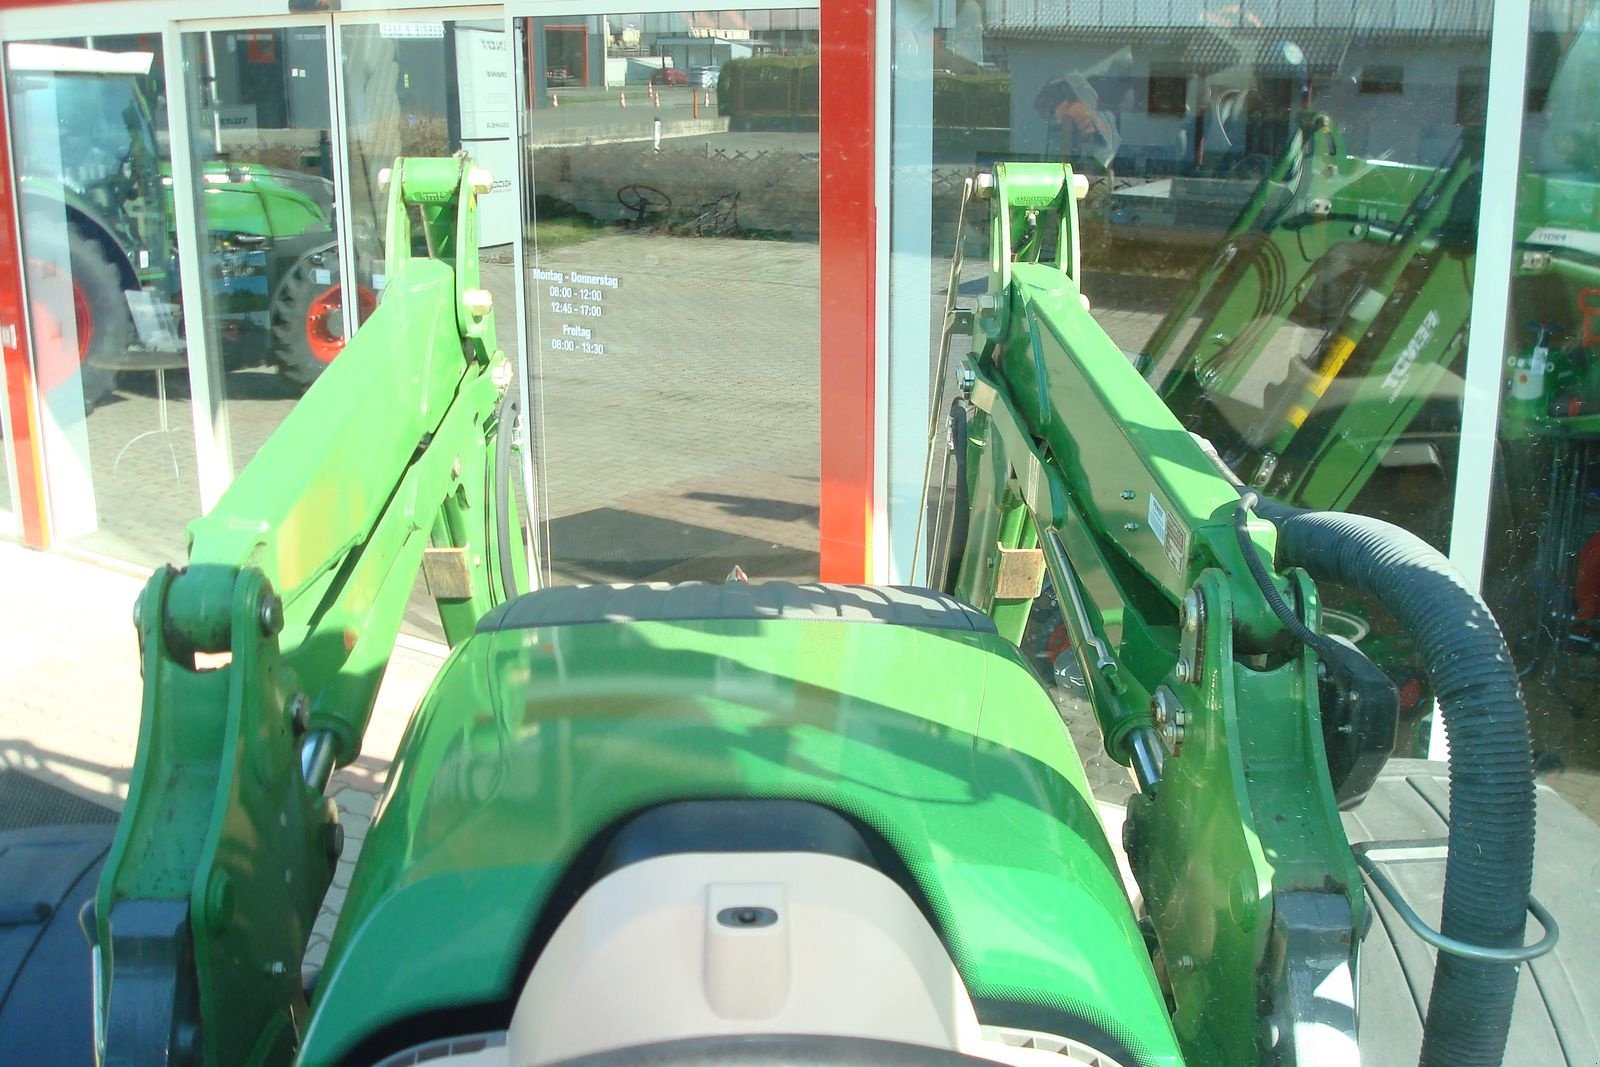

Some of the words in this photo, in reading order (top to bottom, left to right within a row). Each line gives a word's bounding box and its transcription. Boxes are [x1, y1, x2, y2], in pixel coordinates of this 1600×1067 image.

[533, 268, 563, 284] Montag
[571, 272, 619, 289] Donnerstag
[549, 286, 572, 298] 08:00
[580, 289, 602, 301] 12:00
[551, 302, 573, 314] 12:45
[580, 305, 602, 317] 17:00
[562, 324, 592, 339] Freitag
[551, 339, 574, 352] 08:00
[581, 343, 604, 355] 13:30
